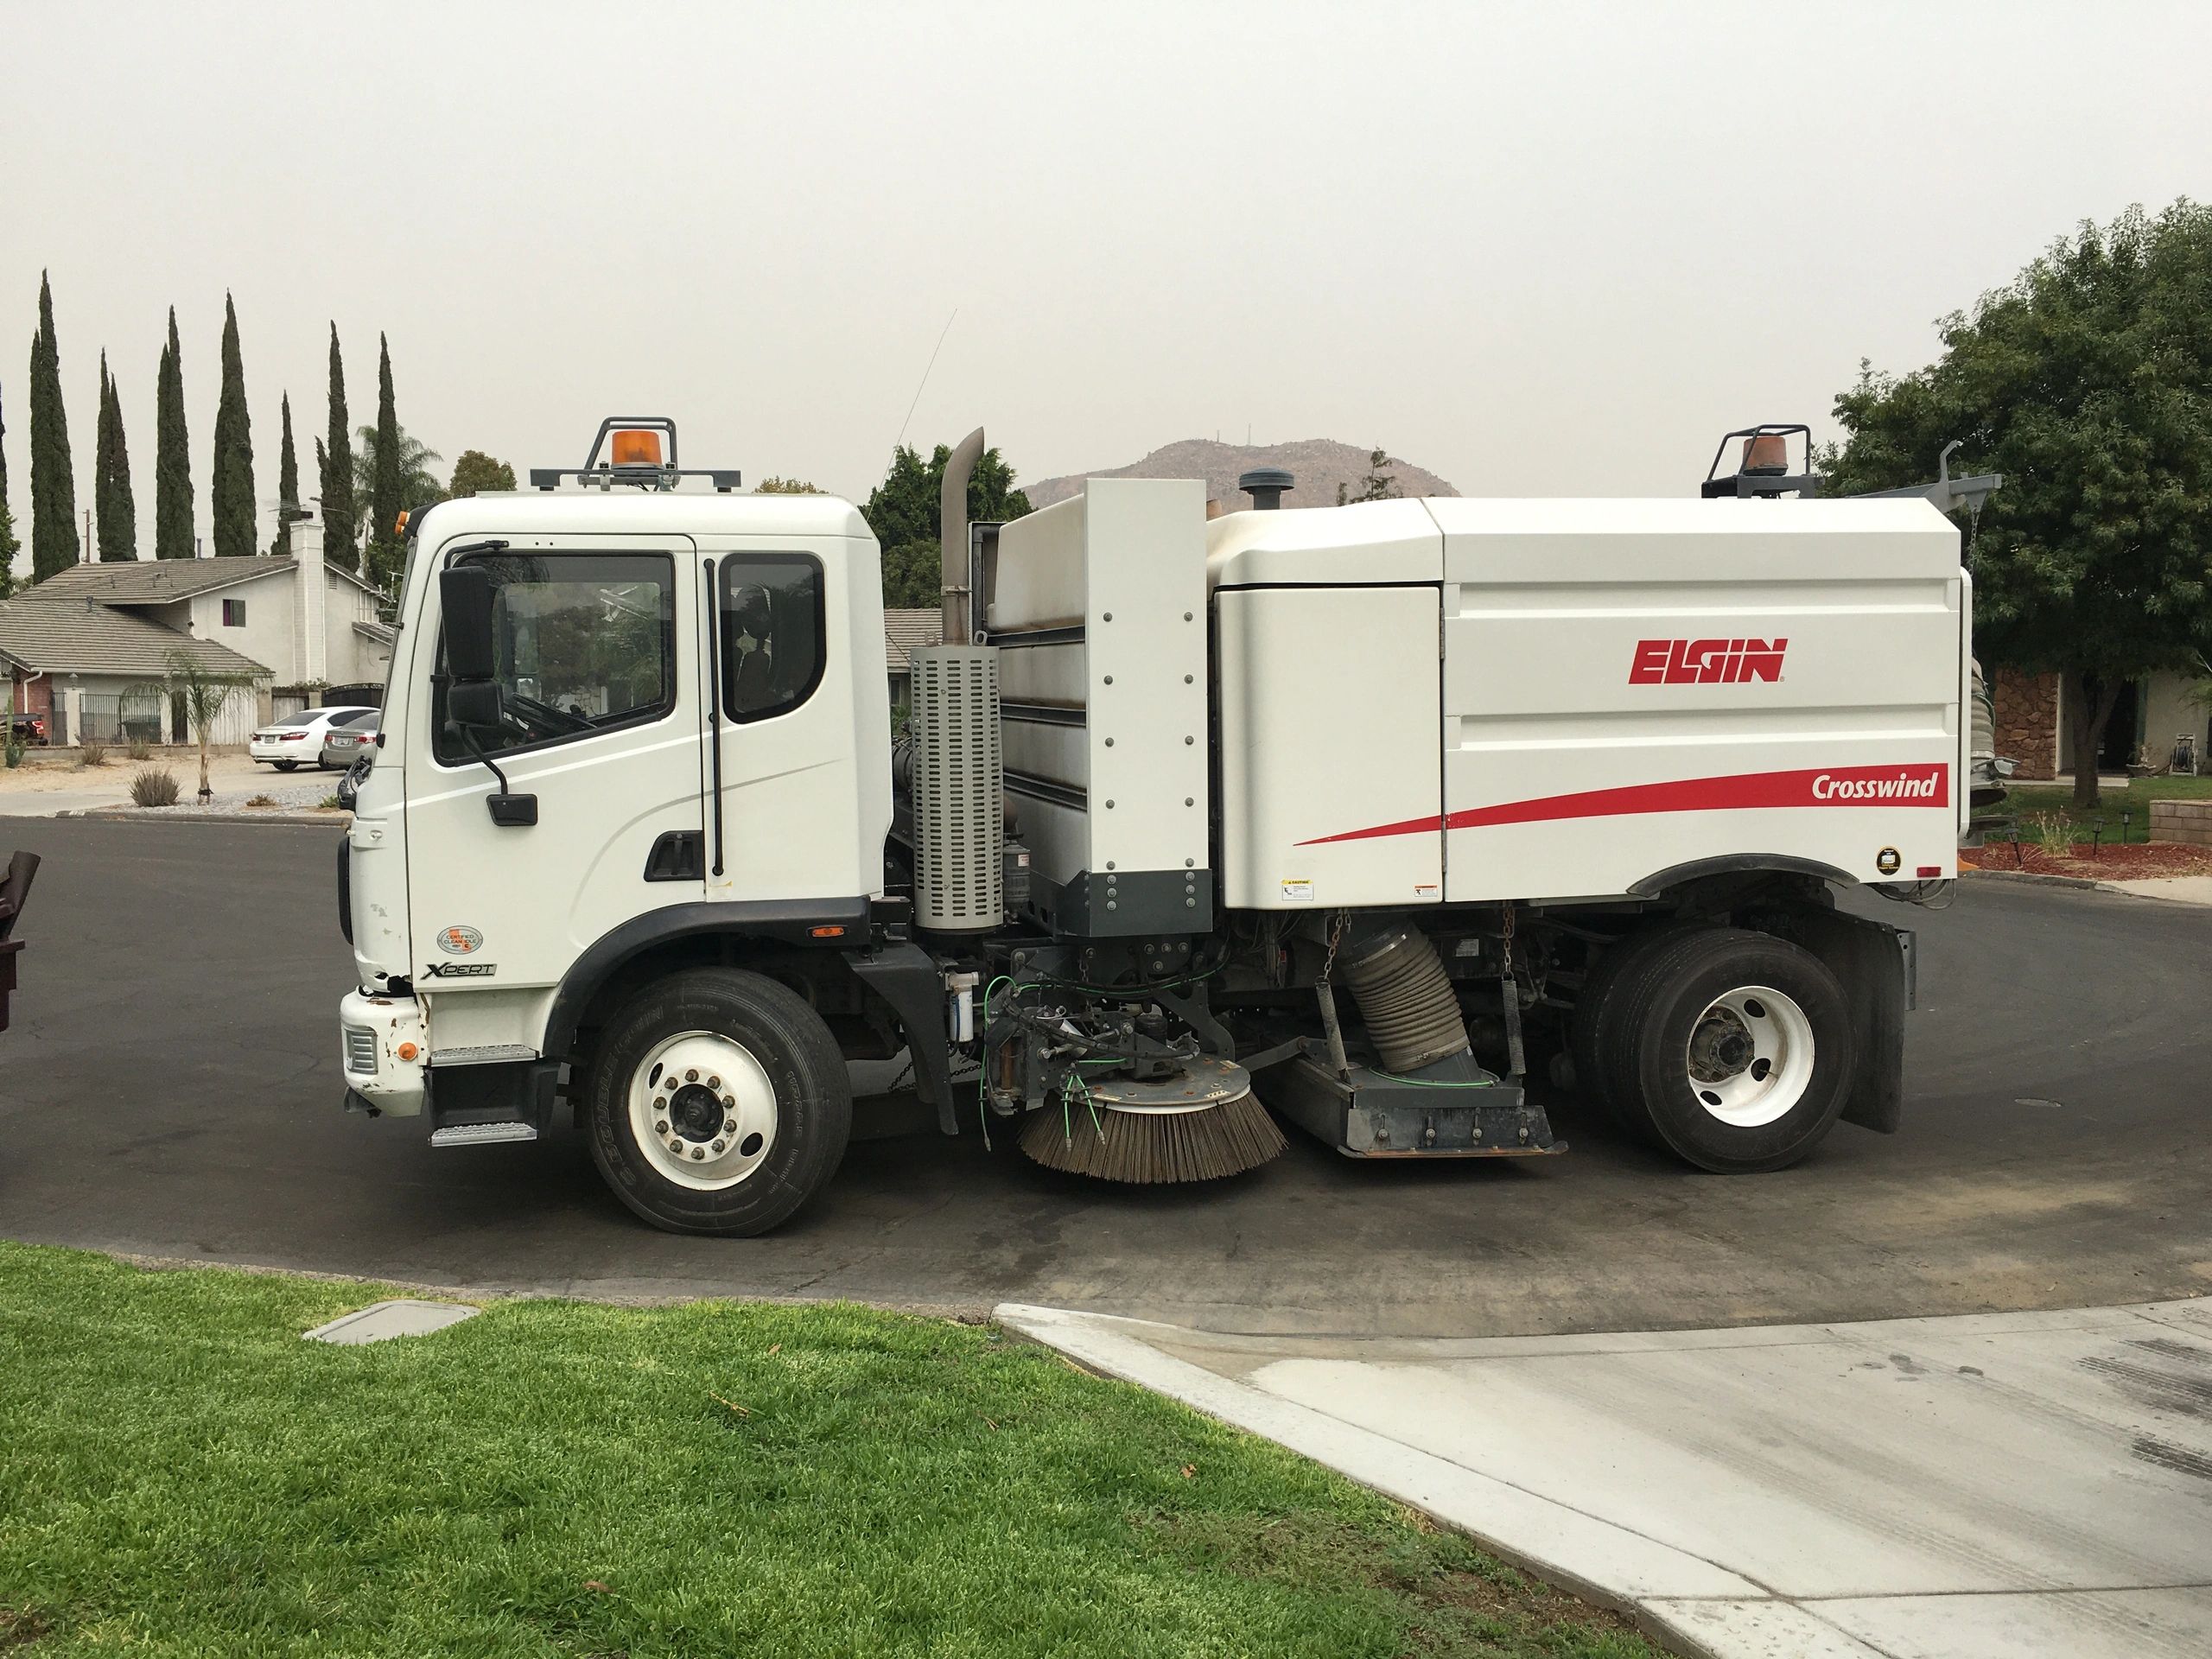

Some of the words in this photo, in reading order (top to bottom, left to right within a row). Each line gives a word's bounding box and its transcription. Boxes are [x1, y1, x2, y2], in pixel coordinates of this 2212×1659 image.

[1628, 639, 1789, 684] ELGIN
[1812, 772, 1939, 799] Crosswind
[420, 962, 495, 981] XPERT
